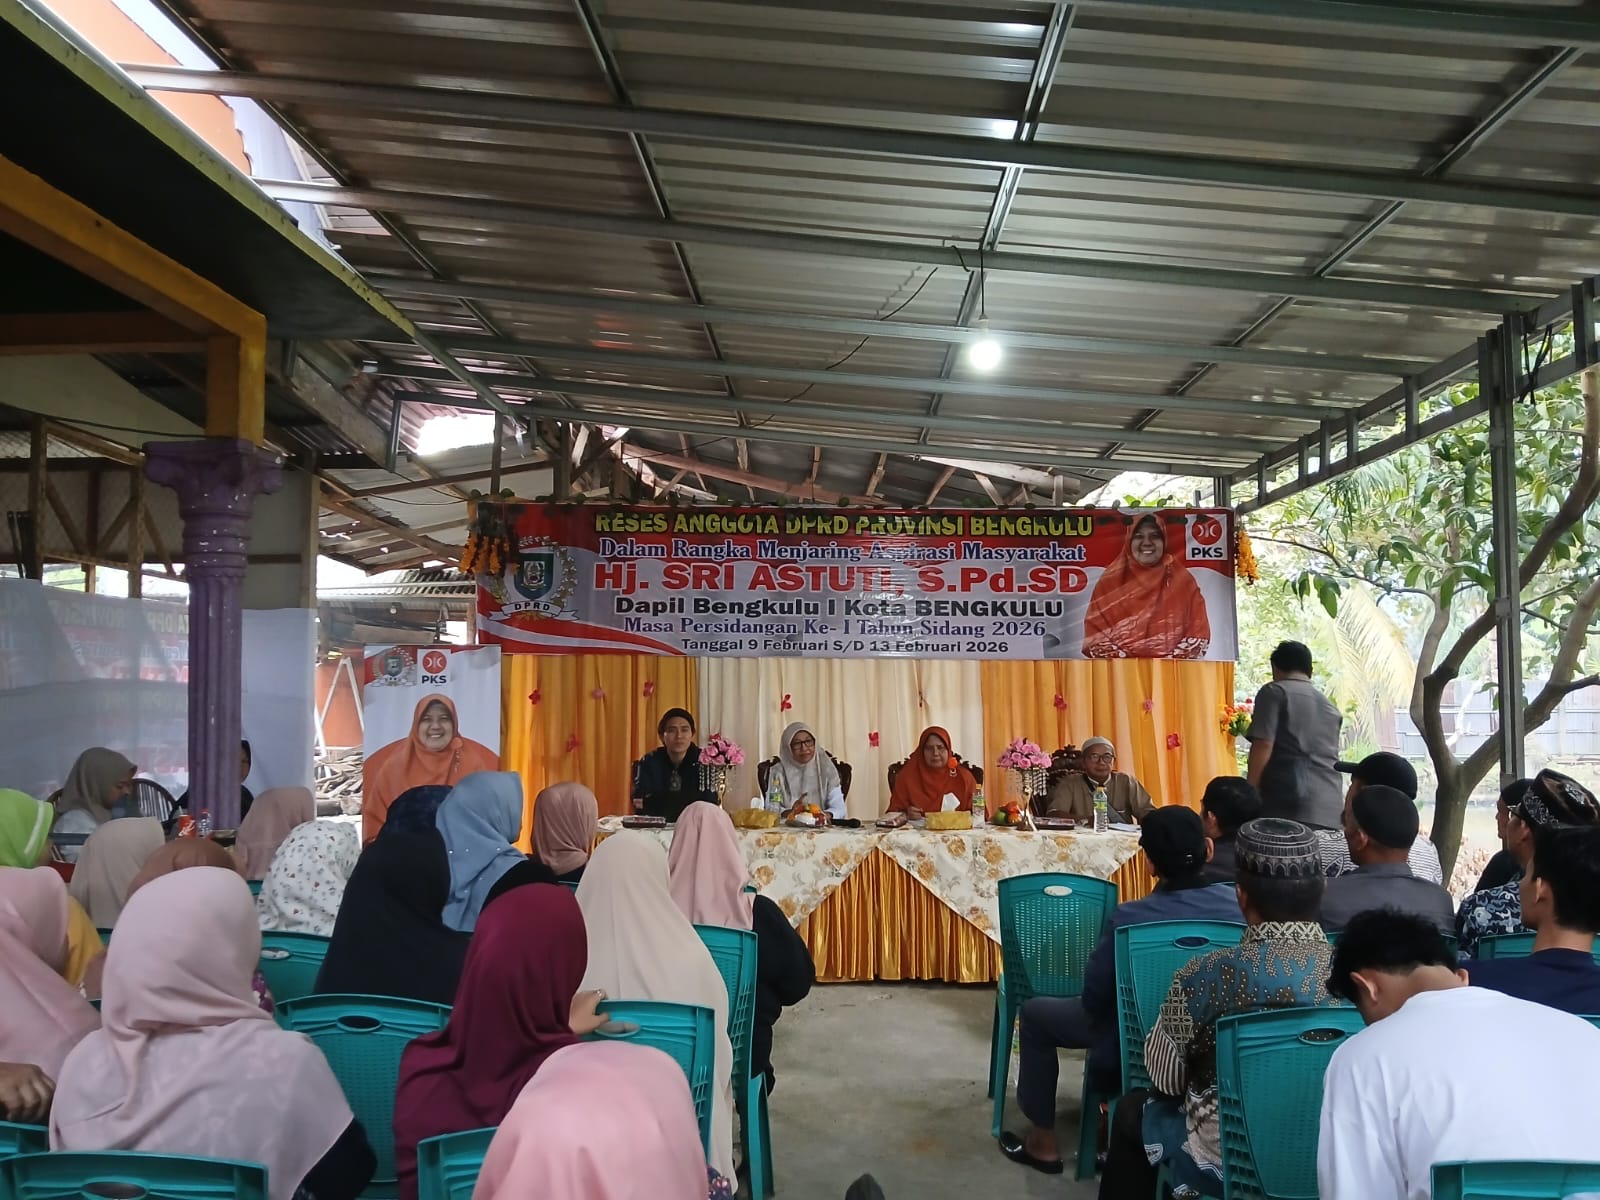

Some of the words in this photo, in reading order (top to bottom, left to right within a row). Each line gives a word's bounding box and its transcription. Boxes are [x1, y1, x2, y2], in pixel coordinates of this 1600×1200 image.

[595, 512, 668, 533] RESES
[673, 513, 780, 534] ANGGOTA
[786, 515, 850, 535] DPRD
[855, 515, 964, 536] PROVINSI
[970, 516, 1093, 536] BENGKULU
[600, 537, 667, 558] Dalam
[671, 538, 752, 561] Rangka
[756, 539, 862, 562] Menjaring
[868, 541, 957, 563] Aspirasi
[961, 541, 1086, 563] Masyarakat
[1191, 547, 1223, 558] PKS
[594, 562, 650, 596] Hj.
[661, 562, 735, 592] SRI
[916, 566, 1089, 594] S.Pd.SD
[514, 602, 550, 611] DPRD
[615, 597, 686, 617] Dapil
[692, 598, 819, 618] Bengkulu
[828, 599, 836, 616] I
[844, 600, 907, 616] Kota
[915, 600, 1063, 617] BENGKULU
[624, 617, 674, 633] Masa
[680, 617, 798, 636] Persidangan
[804, 619, 837, 635] Ke-
[857, 619, 913, 636] Tahun
[920, 620, 985, 638] Sidang
[992, 621, 1046, 637] 2026
[682, 638, 743, 652] Tanggal
[748, 640, 758, 651] 9
[763, 639, 828, 652] Februari
[833, 640, 865, 654] S/D
[870, 640, 890, 652] 13
[896, 640, 961, 653] Februari
[965, 641, 1009, 653] 2026
[421, 675, 447, 684] PKS
